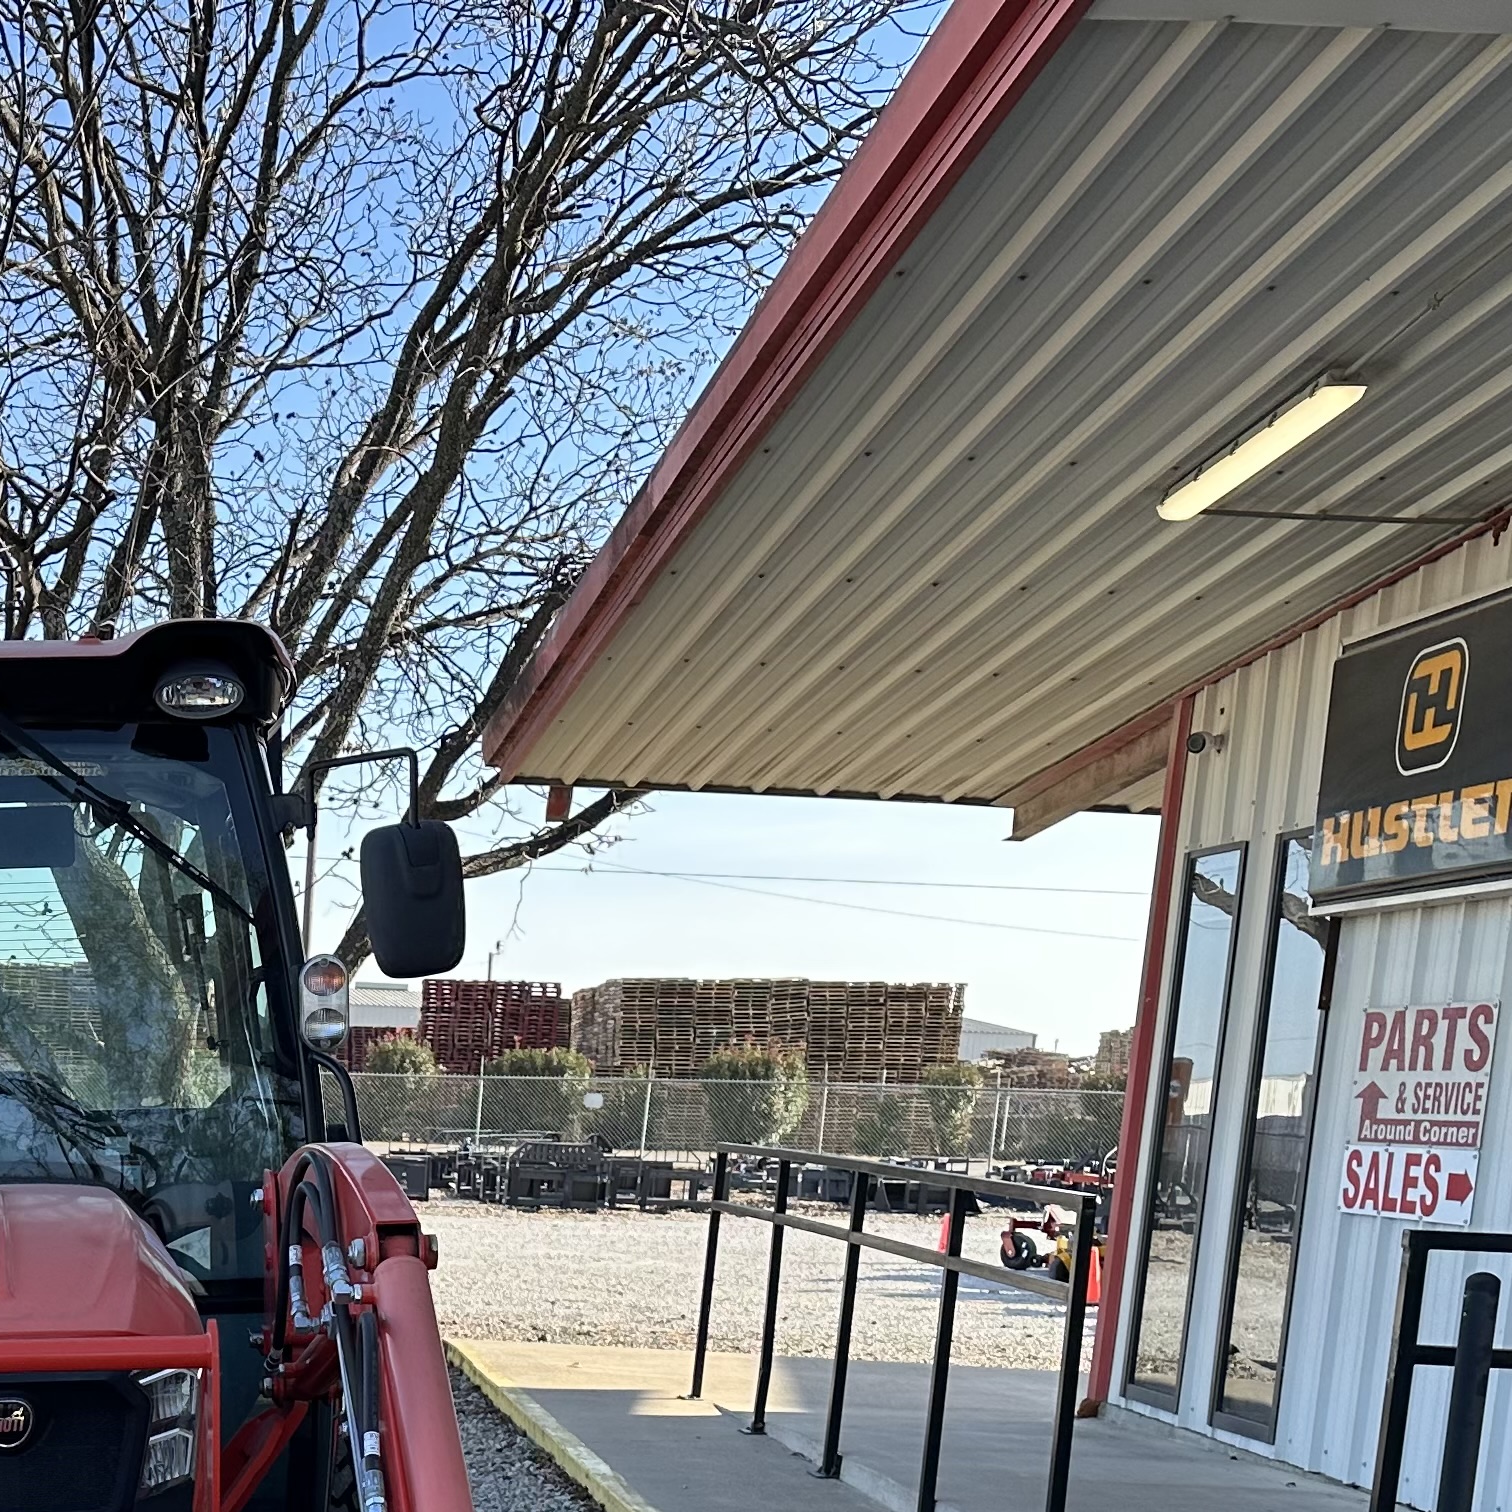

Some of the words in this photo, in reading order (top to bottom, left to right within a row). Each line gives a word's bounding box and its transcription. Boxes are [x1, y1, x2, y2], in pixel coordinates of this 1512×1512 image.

[1358, 1004, 1495, 1073] PARTS
[1395, 1081, 1408, 1115] &
[1411, 1081, 1485, 1116] SERVICE
[1360, 1119, 1416, 1142] Around
[1419, 1121, 1477, 1144] Corner
[1342, 1149, 1442, 1217] SALES
